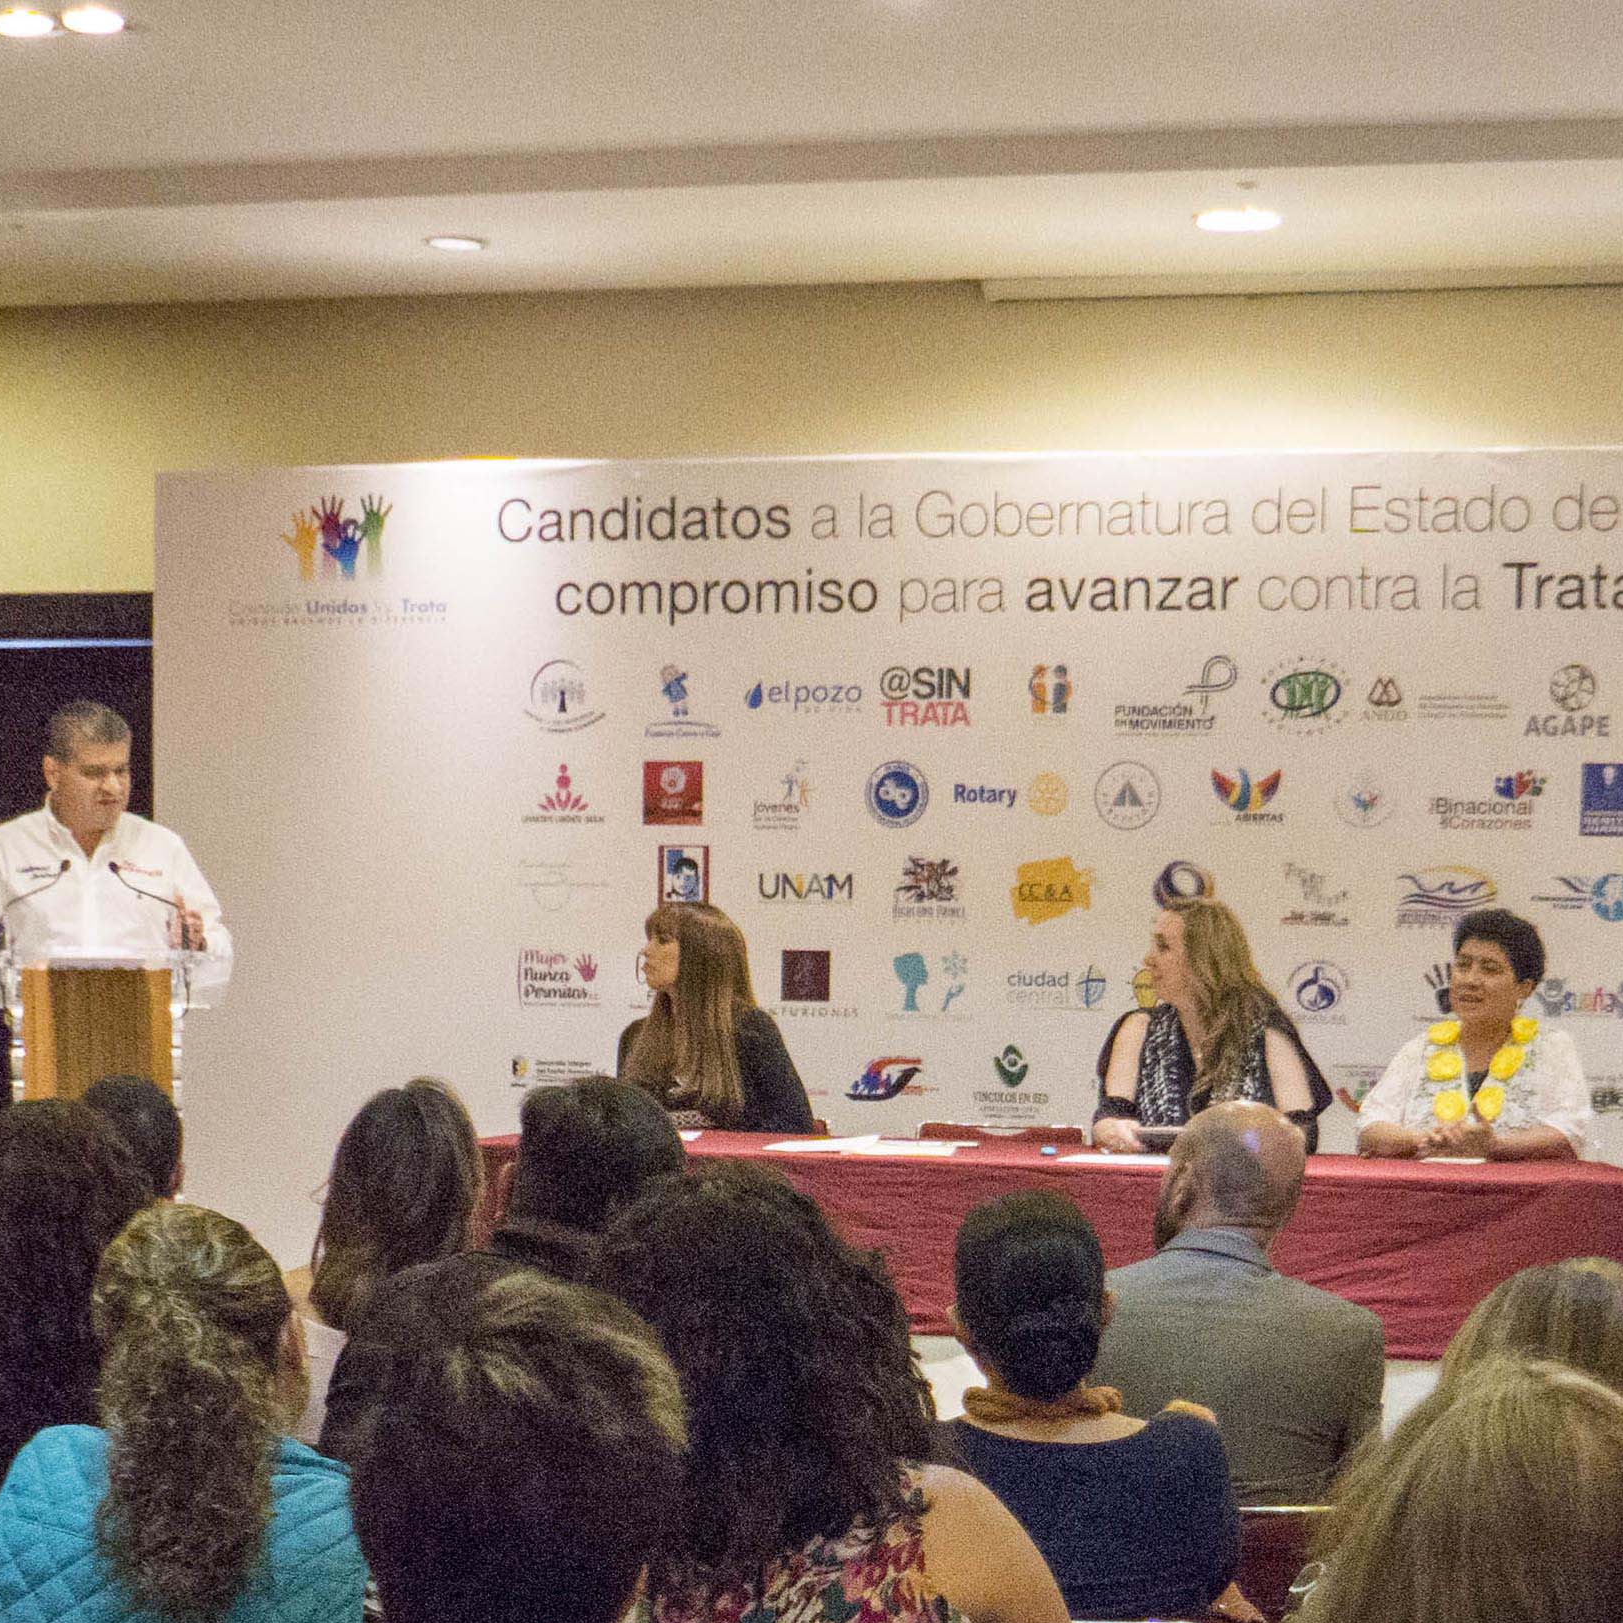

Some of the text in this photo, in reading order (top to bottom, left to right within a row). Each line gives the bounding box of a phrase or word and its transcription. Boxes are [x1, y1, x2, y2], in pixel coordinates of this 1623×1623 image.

[496, 496, 792, 543] Candidatos
[810, 505, 838, 539] a
[858, 491, 895, 539] la
[914, 488, 1233, 538] Gobernatura
[1251, 485, 1327, 535] del
[1349, 482, 1531, 535] Estado
[1551, 482, 1619, 533] de
[306, 599, 368, 615] Unidos
[401, 598, 448, 614] Trata
[555, 568, 878, 626] compromiso
[898, 574, 1005, 623] para
[1025, 572, 1240, 614] avanzar
[1257, 567, 1420, 613] contra
[1441, 563, 1482, 611] la
[879, 665, 971, 701] @SIN
[883, 702, 971, 727] TRATA
[1114, 701, 1194, 720] FUNDACIÓN
[1129, 715, 1216, 730] MOVIMIENTO
[953, 783, 1017, 808] Rotary
[1007, 970, 1069, 988] ciudad
